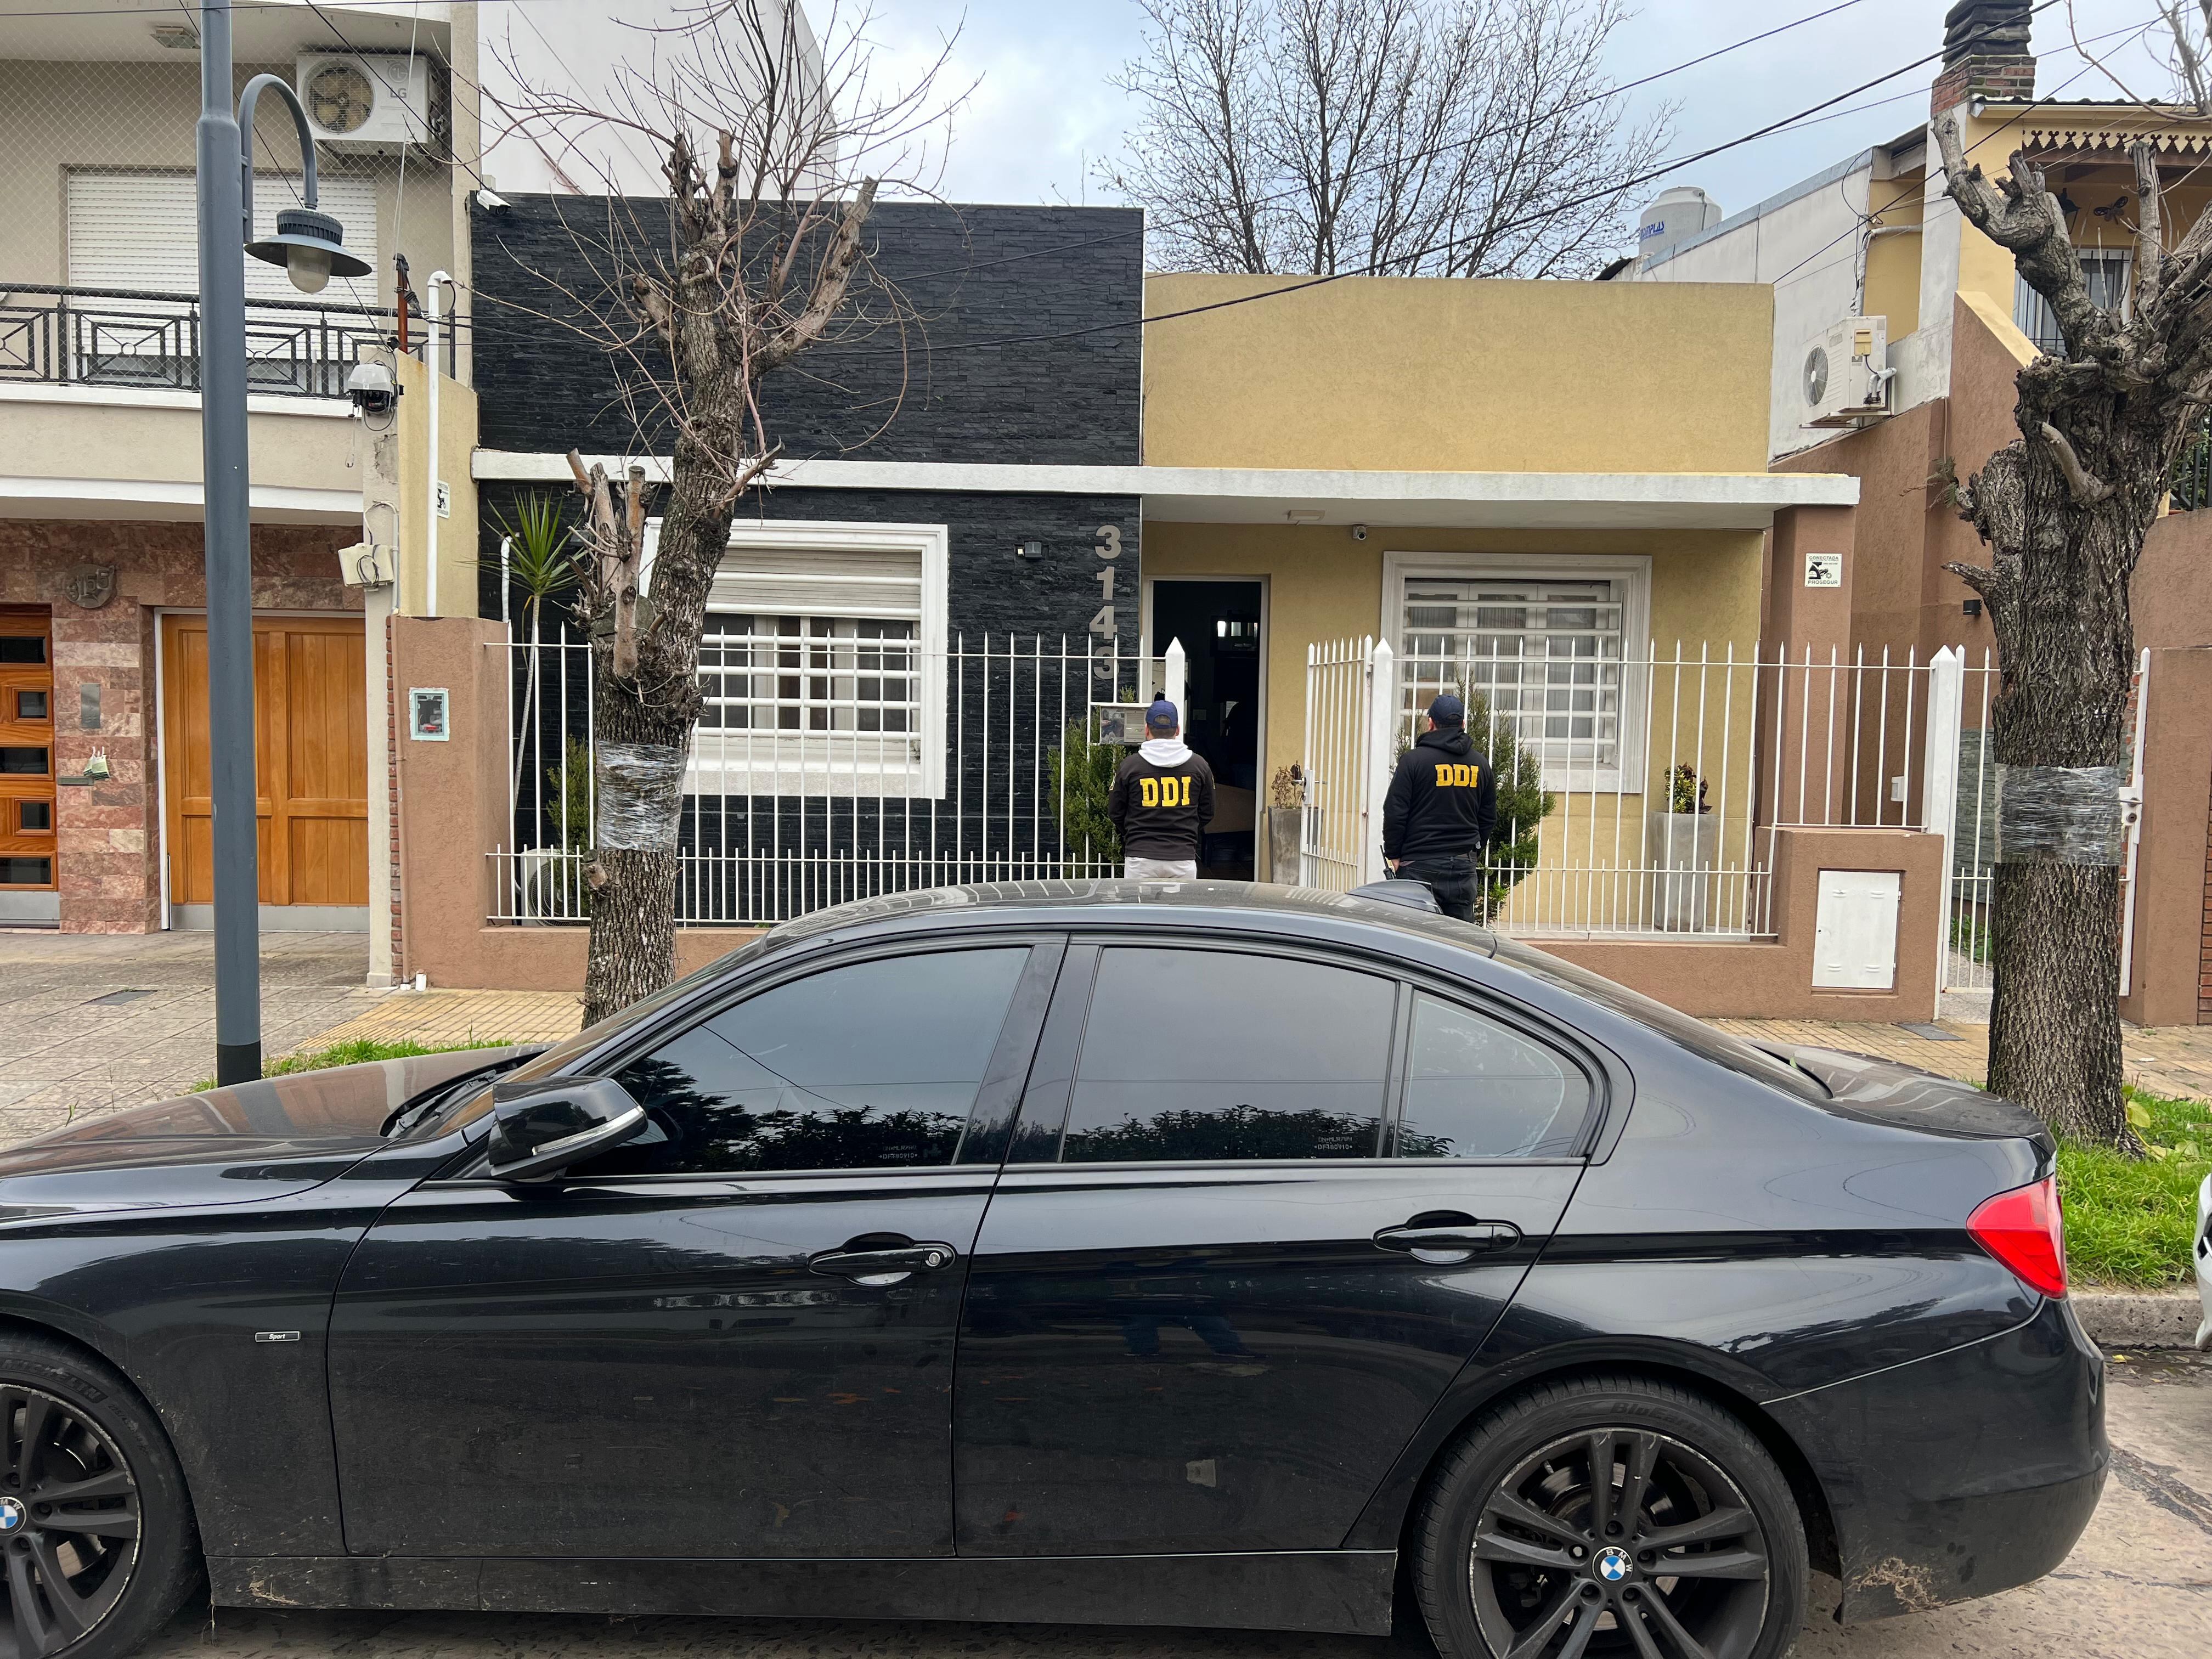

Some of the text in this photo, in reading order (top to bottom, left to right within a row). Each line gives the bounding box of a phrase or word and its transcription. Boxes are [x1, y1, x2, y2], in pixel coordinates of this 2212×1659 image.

[390, 87, 407, 98] LG
[1089, 525, 1121, 680] 3143
[1435, 764, 1479, 787] DDI
[1139, 776, 1191, 807] DDI
[0, 1499, 22, 1510] MW
[1606, 1549, 1633, 1572] BMW
